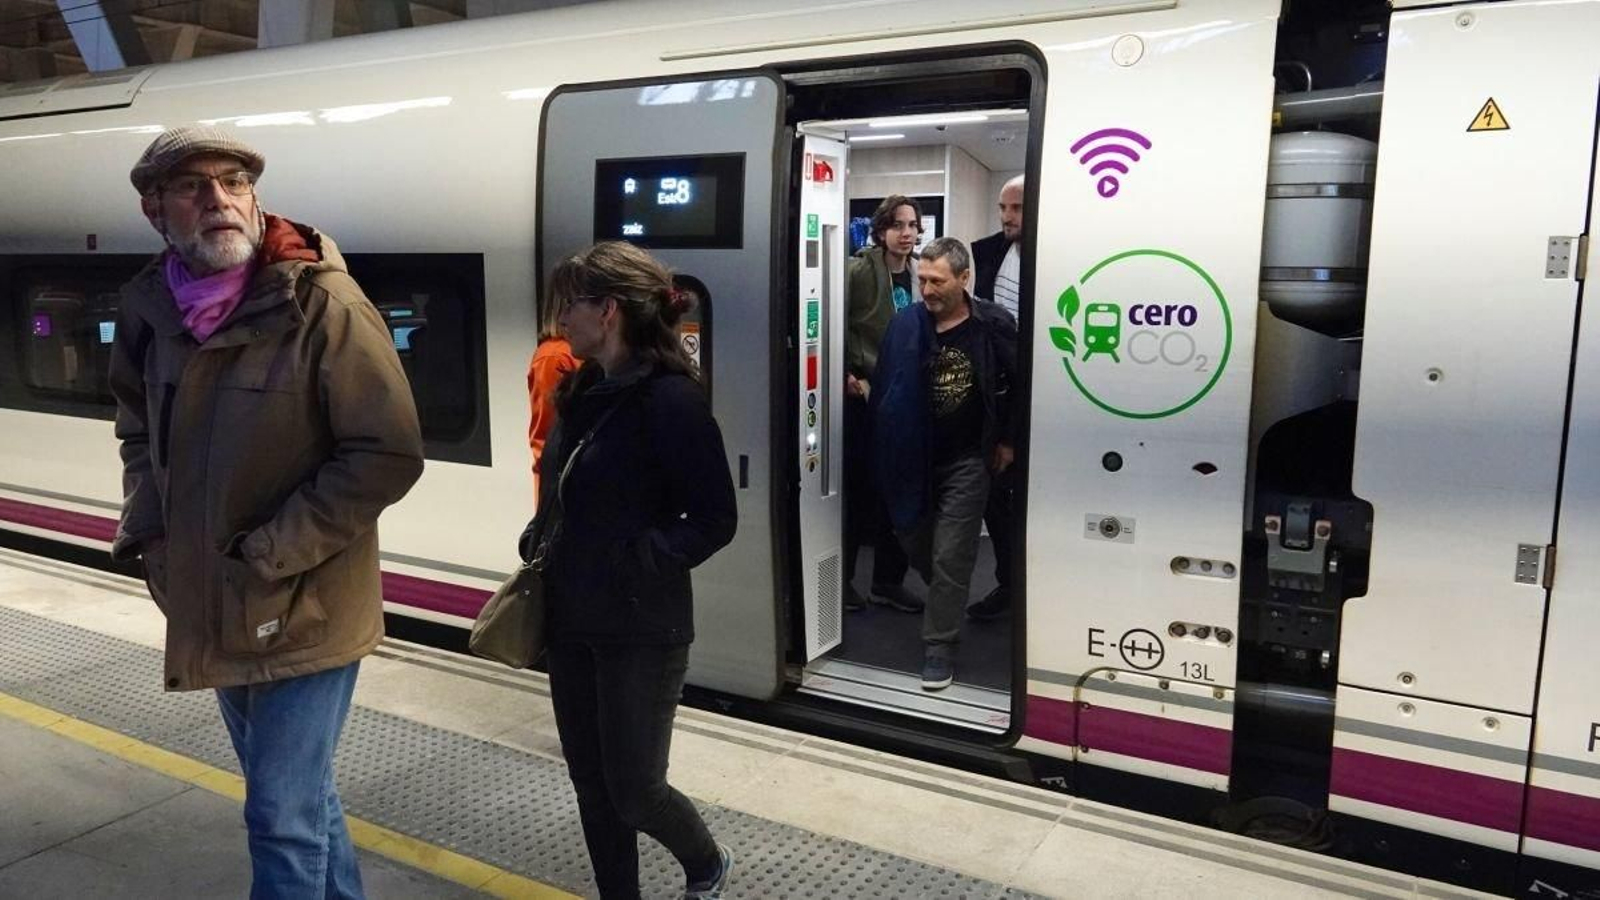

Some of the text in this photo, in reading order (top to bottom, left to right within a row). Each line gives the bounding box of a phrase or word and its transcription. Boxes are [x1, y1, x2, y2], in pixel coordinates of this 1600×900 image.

[677, 179, 690, 204] 8
[1128, 303, 1198, 327] cero
[1180, 661, 1216, 682] 13L
